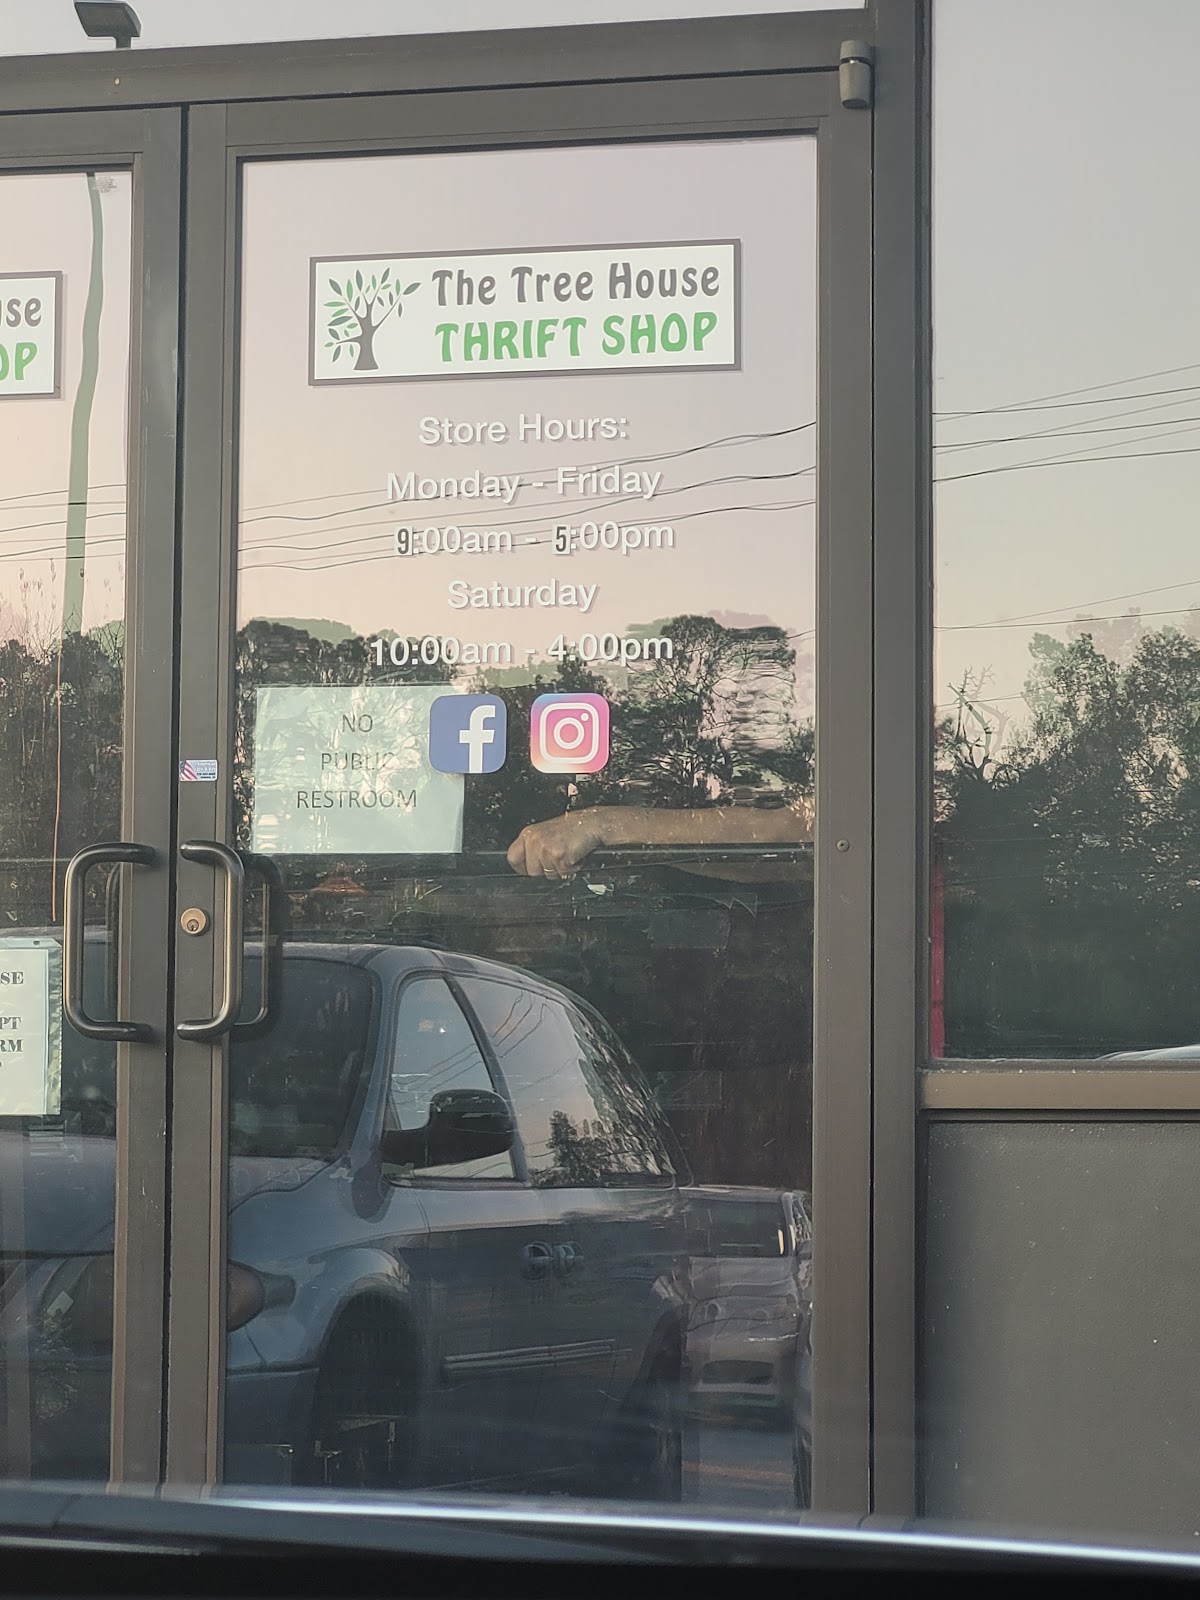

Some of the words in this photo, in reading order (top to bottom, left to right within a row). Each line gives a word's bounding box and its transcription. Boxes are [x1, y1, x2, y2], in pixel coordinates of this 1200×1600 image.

[432, 268, 497, 307] The
[511, 266, 594, 303] Tree
[608, 262, 720, 299] House
[0, 298, 42, 328] se
[435, 317, 587, 362] THRIFT
[601, 312, 718, 356] SHOP
[418, 416, 507, 445] Store
[518, 413, 629, 442] Hours:
[386, 470, 521, 504] Monday
[556, 465, 663, 500] Friday
[396, 525, 513, 555] 9:00am
[555, 520, 675, 555] 5:00pm
[447, 578, 598, 613] Saturday
[370, 636, 513, 666] 10:00am
[546, 633, 674, 667] 4:00pm
[342, 714, 374, 733] NO
[297, 789, 417, 809] RESTROOM
